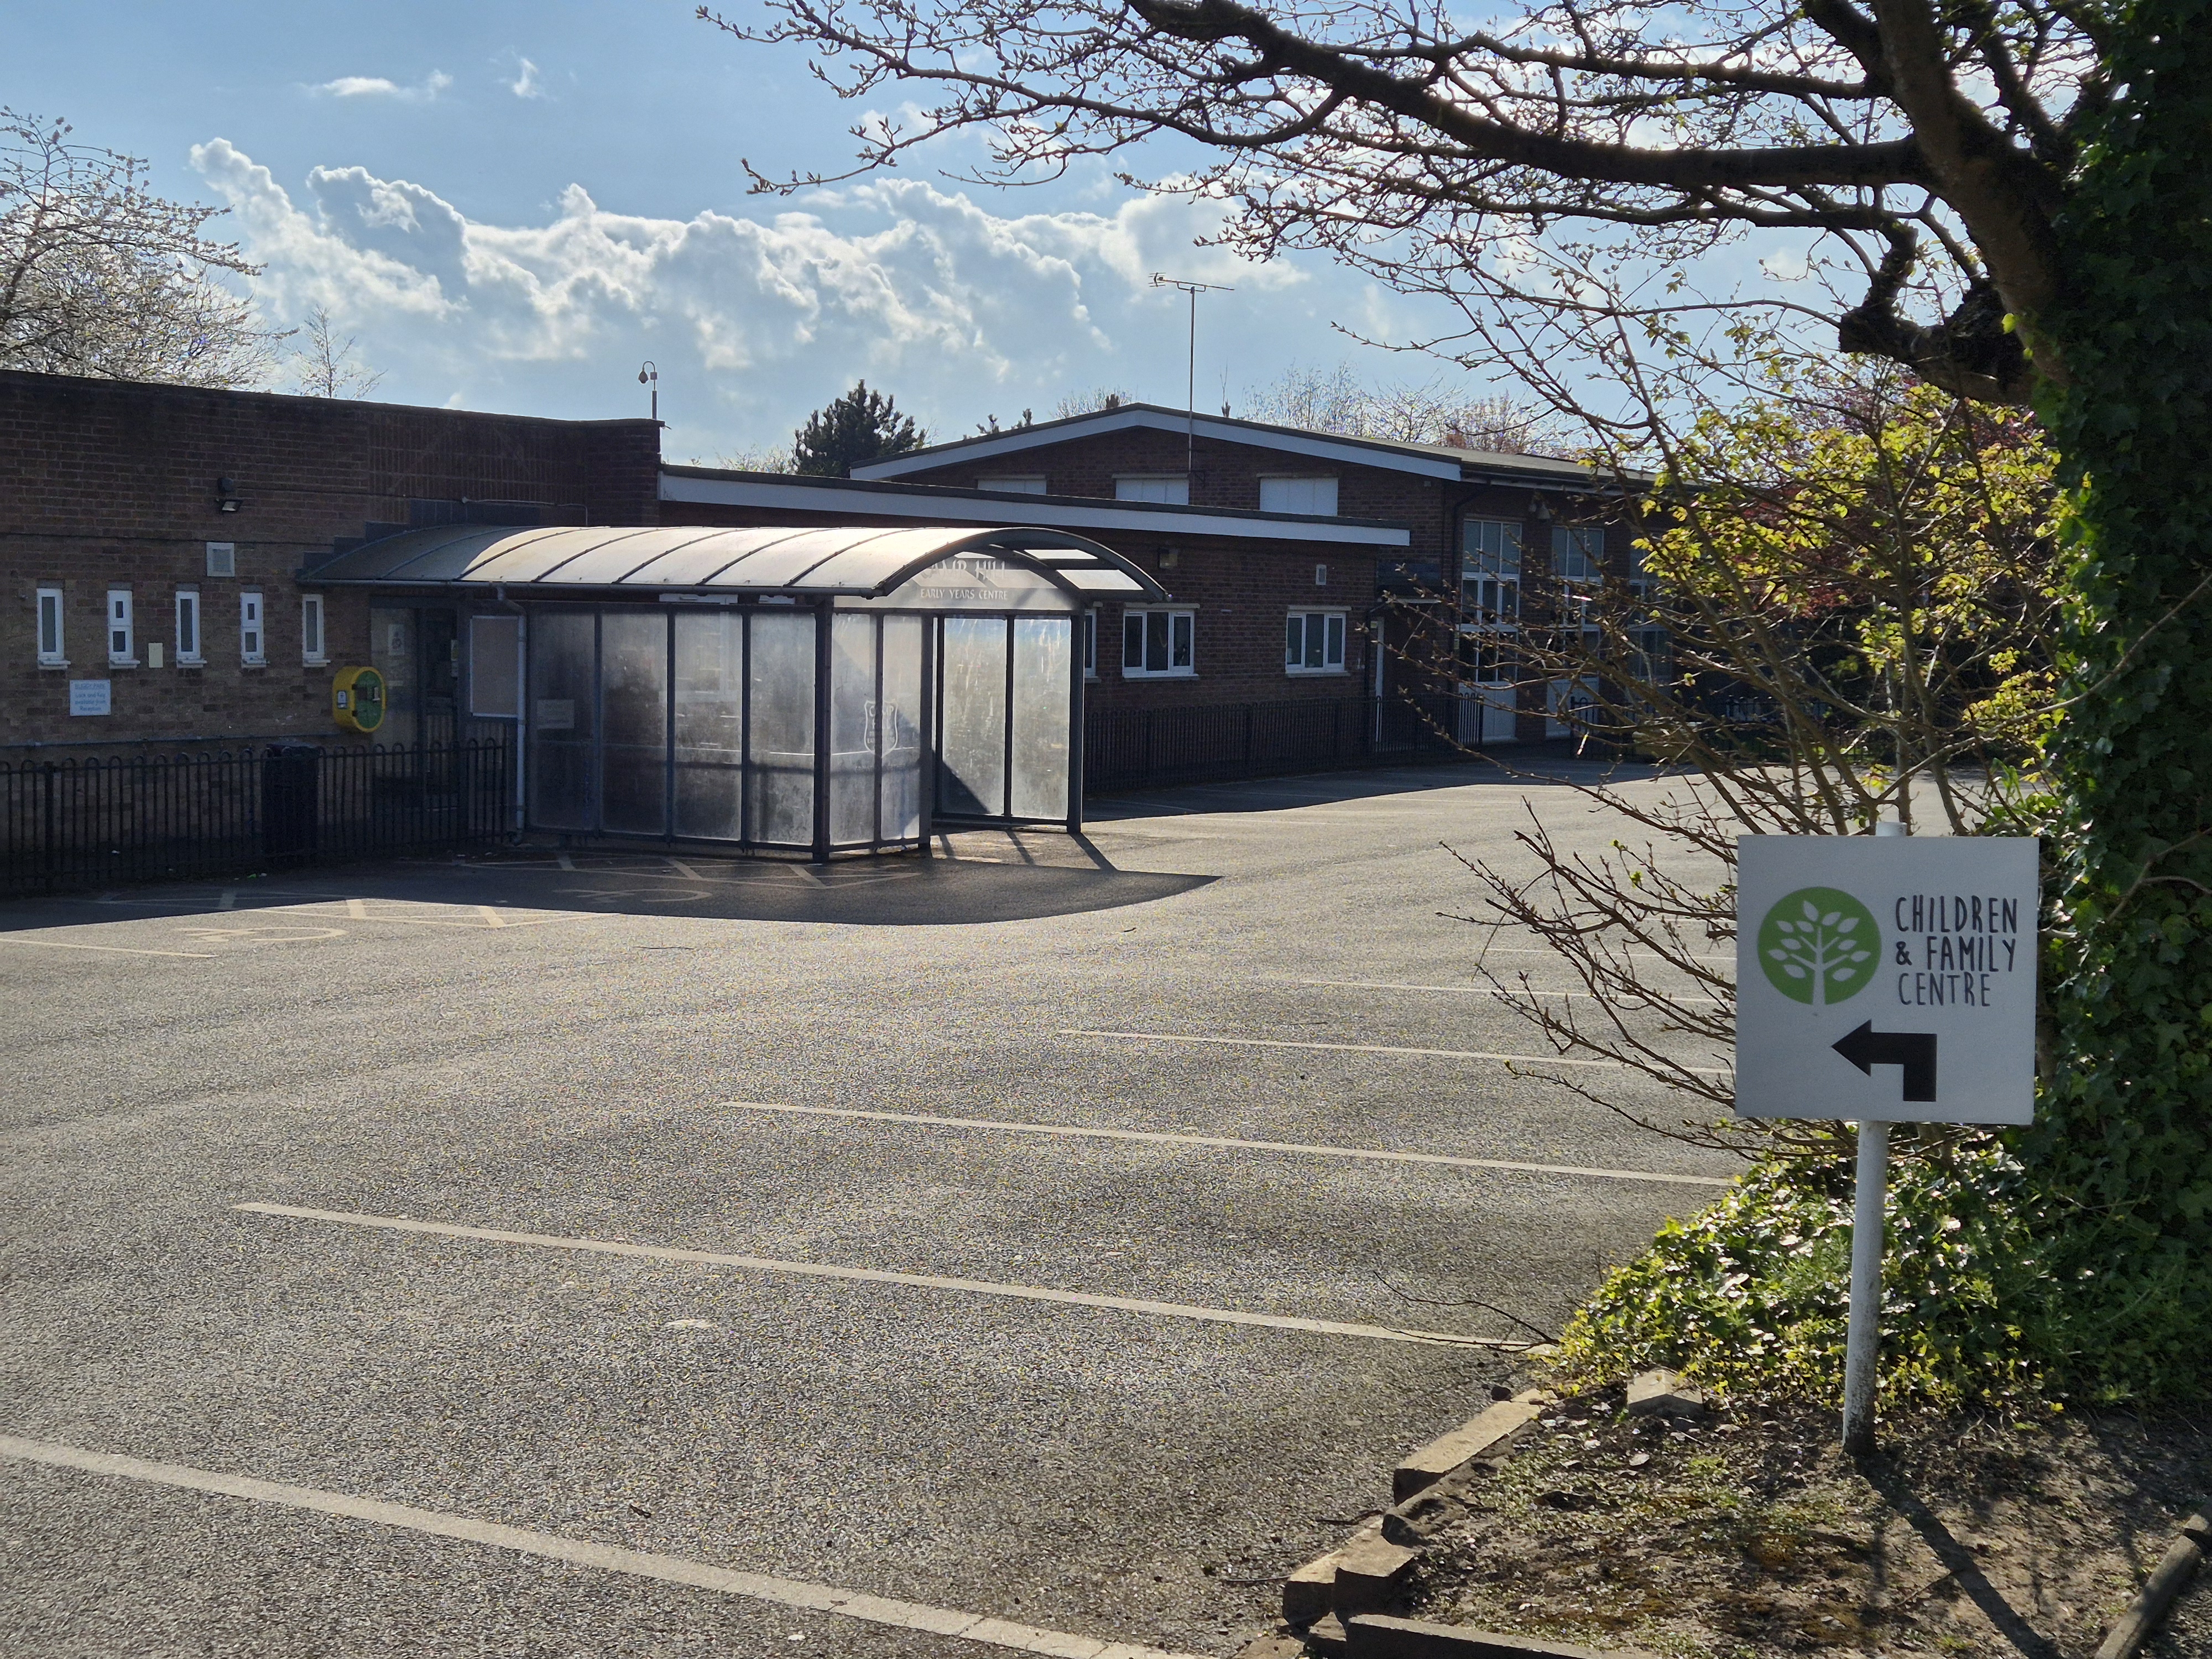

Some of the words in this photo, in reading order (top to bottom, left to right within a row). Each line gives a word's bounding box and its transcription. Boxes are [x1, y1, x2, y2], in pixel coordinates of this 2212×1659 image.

[975, 560, 1008, 580] HILL
[920, 588, 945, 598] EARLY
[949, 589, 975, 599] YEARS
[979, 589, 1008, 600] CENTRE
[1895, 894, 2017, 933] CHILDREN
[1895, 941, 1913, 966] &
[1927, 935, 2016, 972] FAMILY
[1898, 972, 1991, 1006] CENTRE
